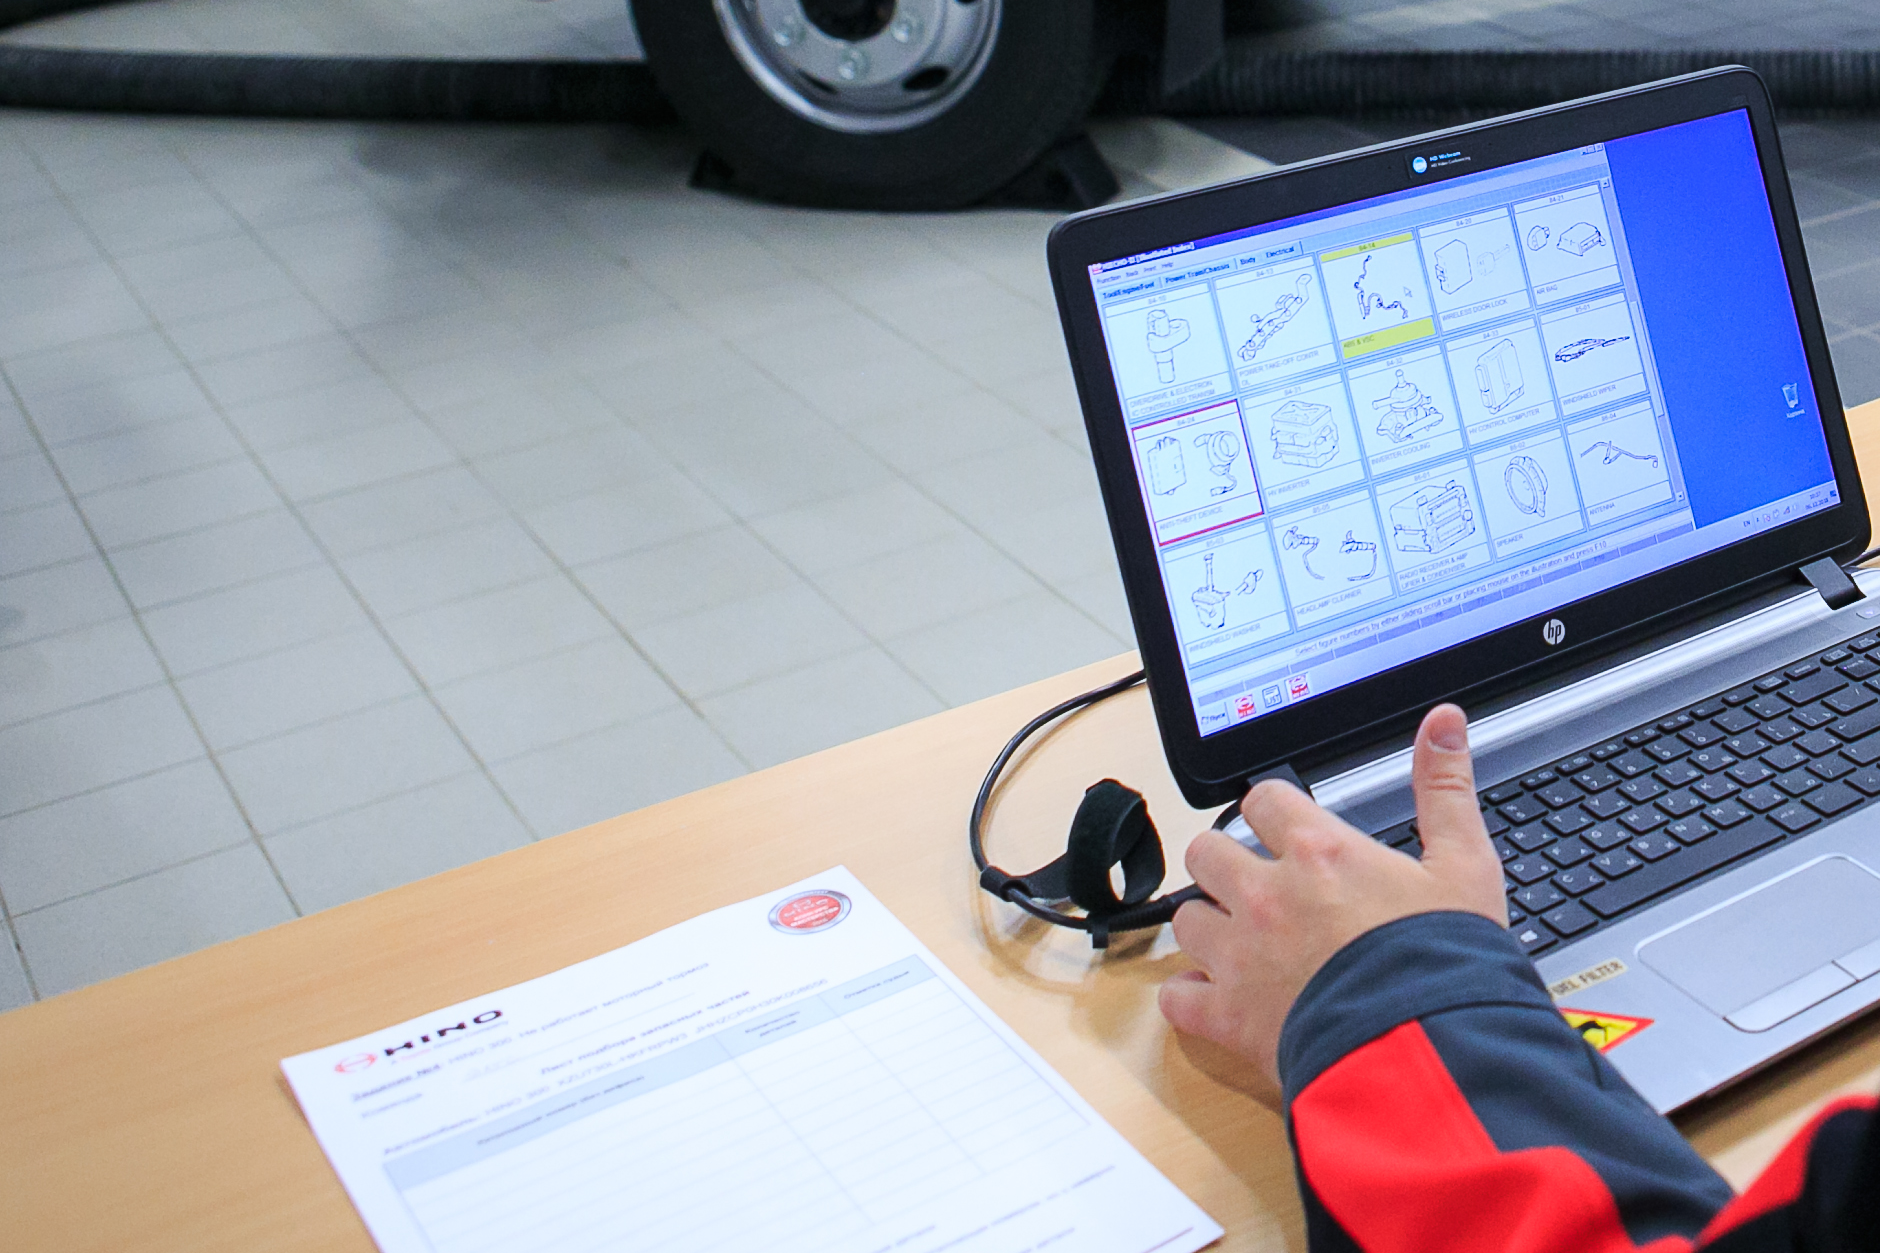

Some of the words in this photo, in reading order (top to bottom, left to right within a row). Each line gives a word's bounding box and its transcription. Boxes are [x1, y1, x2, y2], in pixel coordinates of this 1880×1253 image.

[1239, 255, 1256, 266] Body
[1265, 245, 1295, 259] Electrical
[1164, 273, 1186, 284] Power
[1535, 287, 1545, 296] AIR
[1545, 284, 1558, 293] BAG
[1441, 307, 1472, 322] WIRELESS
[1472, 302, 1491, 313] DOOR
[1490, 298, 1507, 308] LOCK
[1238, 365, 1264, 378] POWER
[1264, 356, 1295, 371] TAKE-OFF
[1295, 350, 1319, 362] CONTR
[1128, 391, 1169, 408] OVERDRIVE
[1175, 379, 1213, 395] ELECTRON
[1140, 395, 1187, 415] CONTROLLED
[1561, 389, 1598, 406] WINDSHIELD
[1597, 383, 1616, 395] WIPER
[1468, 426, 1478, 435] HV
[1477, 417, 1507, 432] CONTROL
[1507, 407, 1540, 423] COMPUTER
[1370, 450, 1402, 465] INVERTER
[1402, 441, 1430, 456] COOLING
[1277, 478, 1310, 494] INVERTER
[1158, 513, 1198, 531] ANTI-THEFT
[1197, 505, 1223, 519] DEVICE
[1588, 501, 1615, 515] ANTENNA
[1496, 532, 1523, 547] SPEAKER
[1398, 569, 1419, 581] RADIO
[1418, 558, 1450, 574] RECEIVER
[1455, 552, 1468, 561] AMP
[1426, 561, 1466, 581] CONDENSER
[1294, 642, 1317, 657] Select
[1317, 635, 1338, 651] figure
[1339, 623, 1370, 642] numbers
[1380, 613, 1400, 627] either
[1400, 605, 1423, 621] sliding
[1423, 598, 1442, 612] scroll
[1462, 582, 1487, 599] placing
[1487, 576, 1510, 589] mouse
[1530, 555, 1563, 573] illustration
[1563, 551, 1575, 562] and
[1575, 546, 1594, 559] press
[1296, 598, 1331, 616] HEADLAMP
[1331, 588, 1361, 604] CLEANER
[1188, 632, 1231, 653] WINDSHIELD
[1231, 622, 1261, 638] WASHER
[1544, 619, 1565, 645] hp
[1579, 960, 1623, 984] FILTER
[539, 1004, 599, 1031] работает
[600, 979, 665, 1008] моторный
[664, 961, 711, 982] тормоз
[382, 1007, 505, 1058] HINO
[539, 1057, 574, 1075] Лист
[576, 1033, 637, 1062] подбора
[638, 1008, 704, 1037] запасных
[705, 989, 751, 1011] частей
